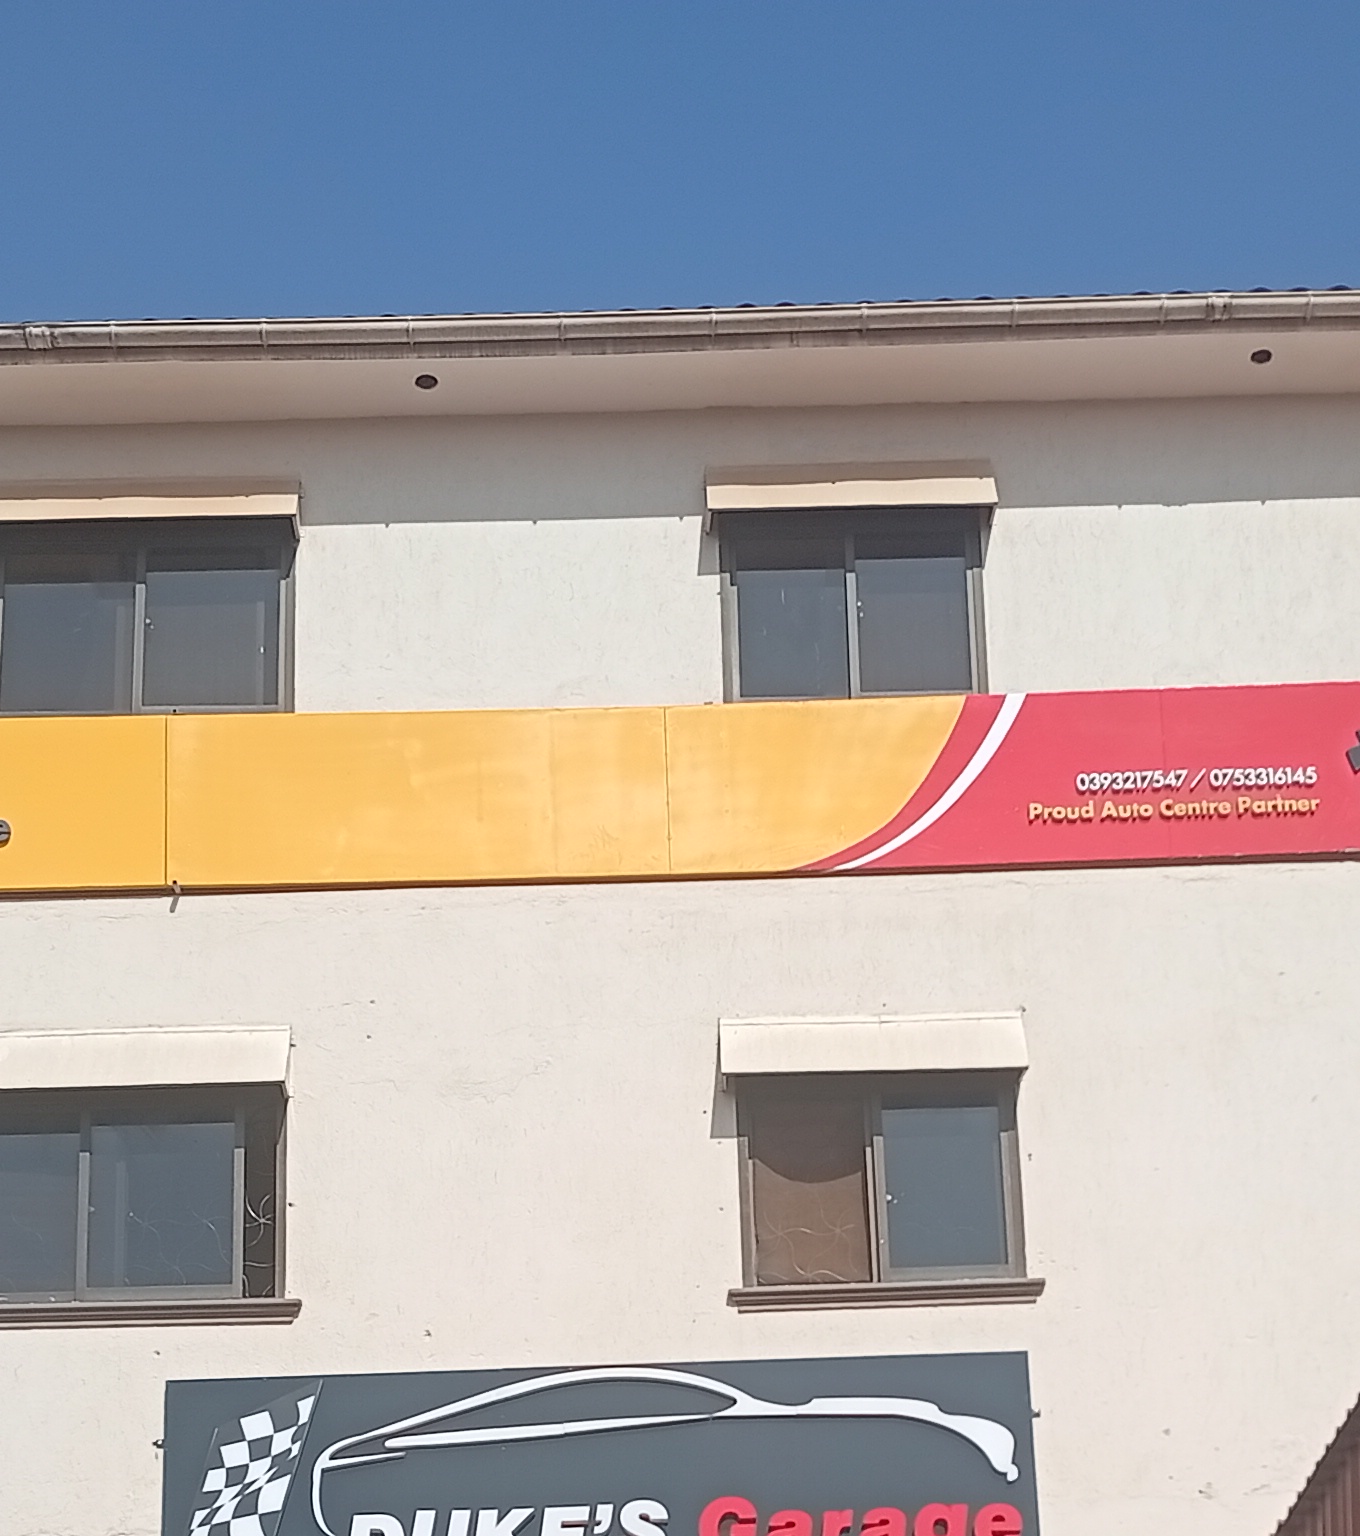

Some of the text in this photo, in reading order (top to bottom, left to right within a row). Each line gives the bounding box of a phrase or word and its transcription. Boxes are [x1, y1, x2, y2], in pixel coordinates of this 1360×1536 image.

[1075, 768, 1188, 795] 0393217547
[1209, 765, 1318, 789] 0753316145
[1028, 795, 1321, 824] Proud Auto Centre Partner
